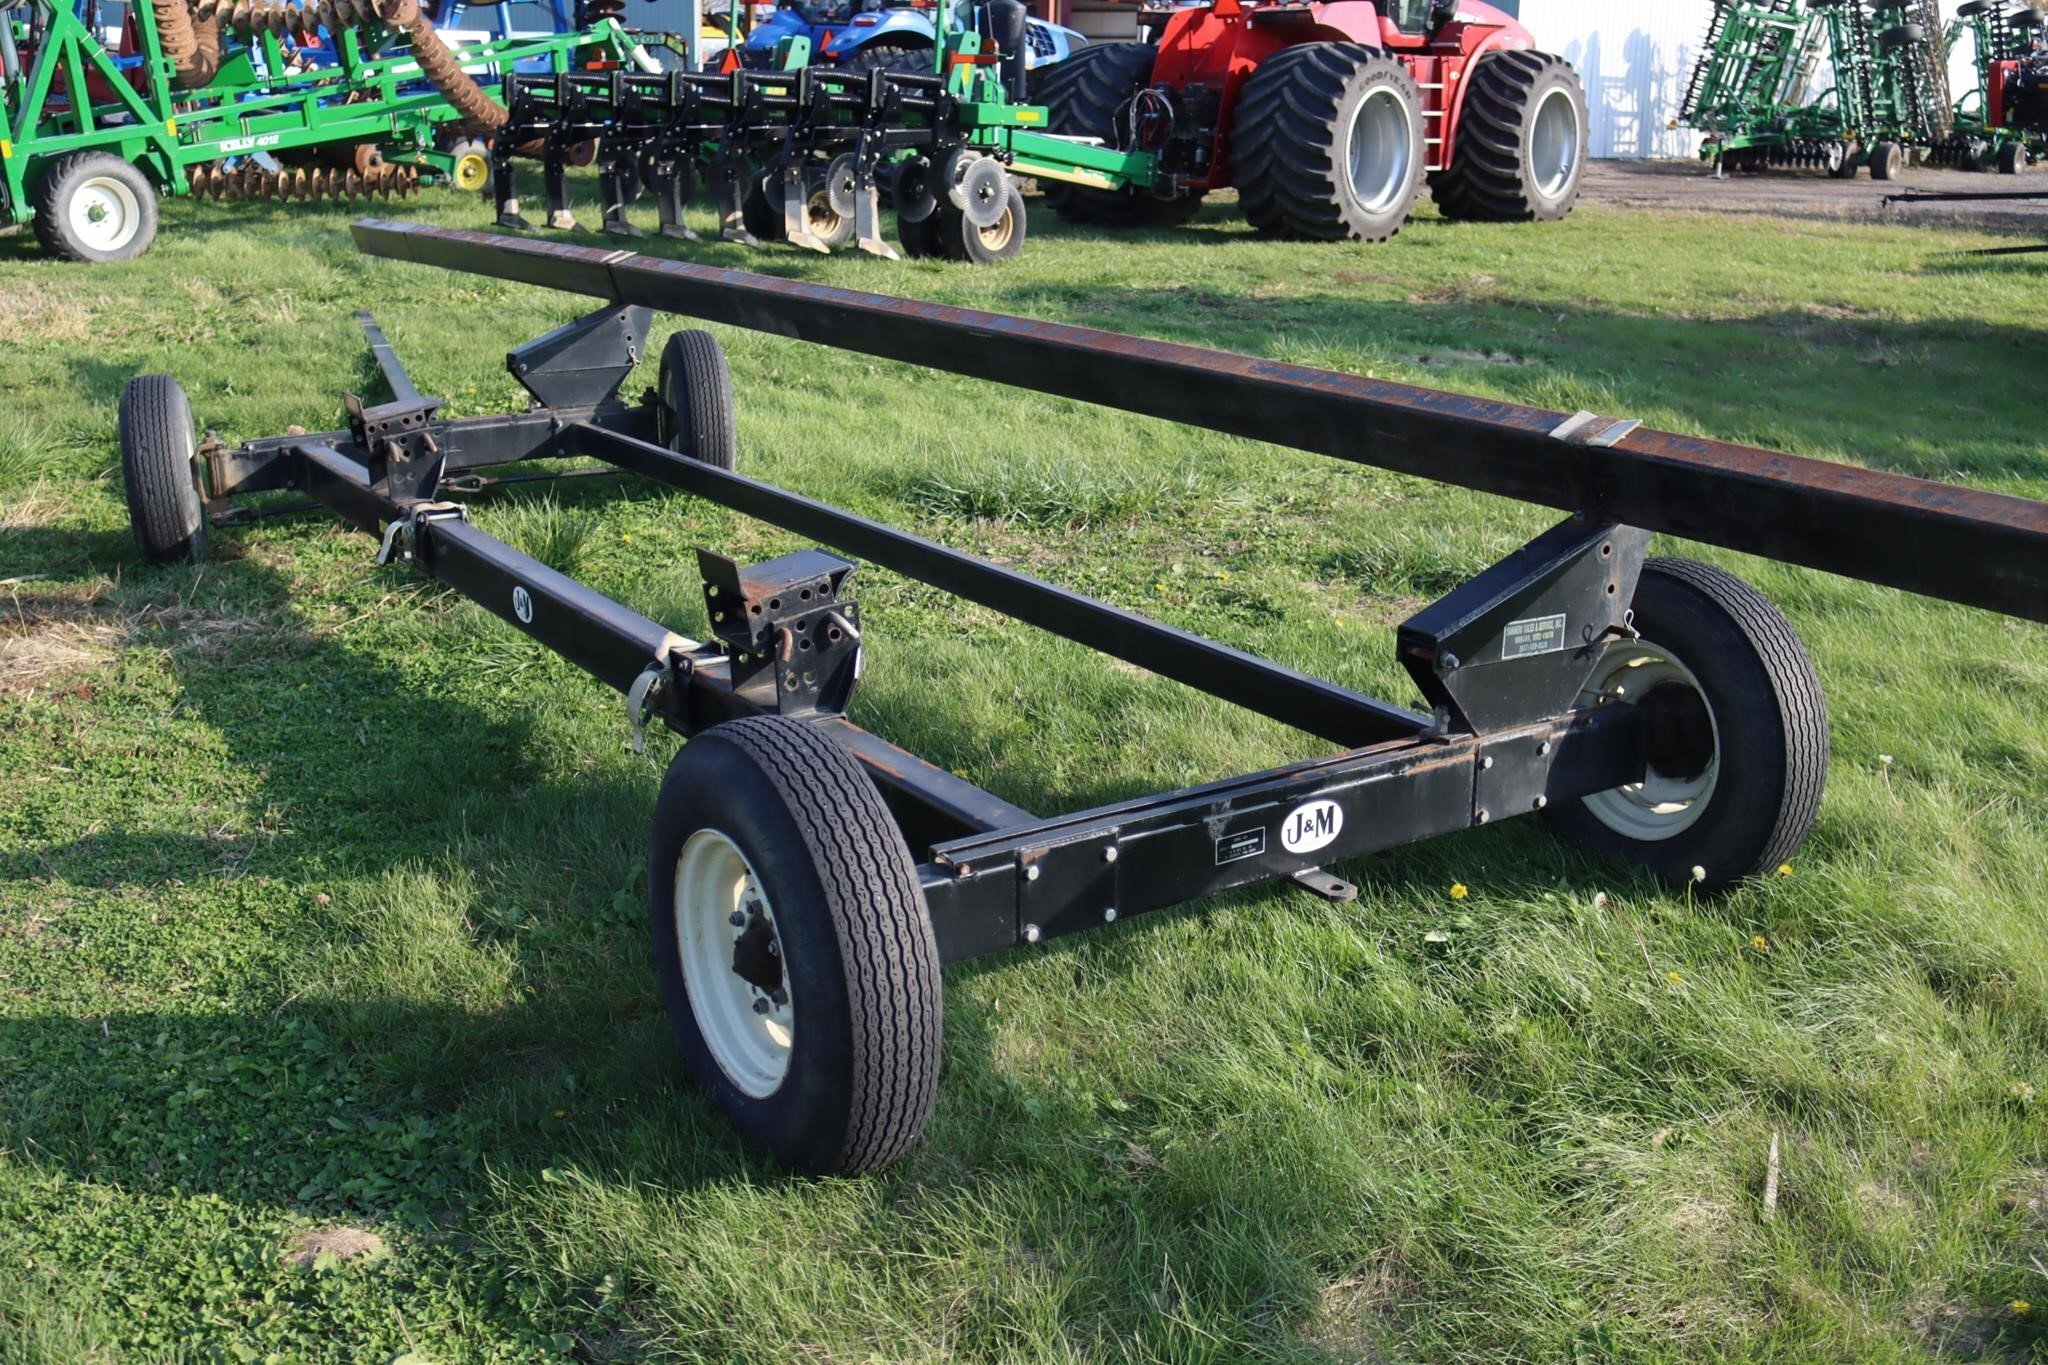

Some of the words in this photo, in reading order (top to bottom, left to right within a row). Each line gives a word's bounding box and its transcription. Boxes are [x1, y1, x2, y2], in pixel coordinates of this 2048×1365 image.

[1359, 70, 1412, 100] GOODYEAR
[219, 136, 255, 152] KELLY
[1286, 805, 1335, 845] J&M
